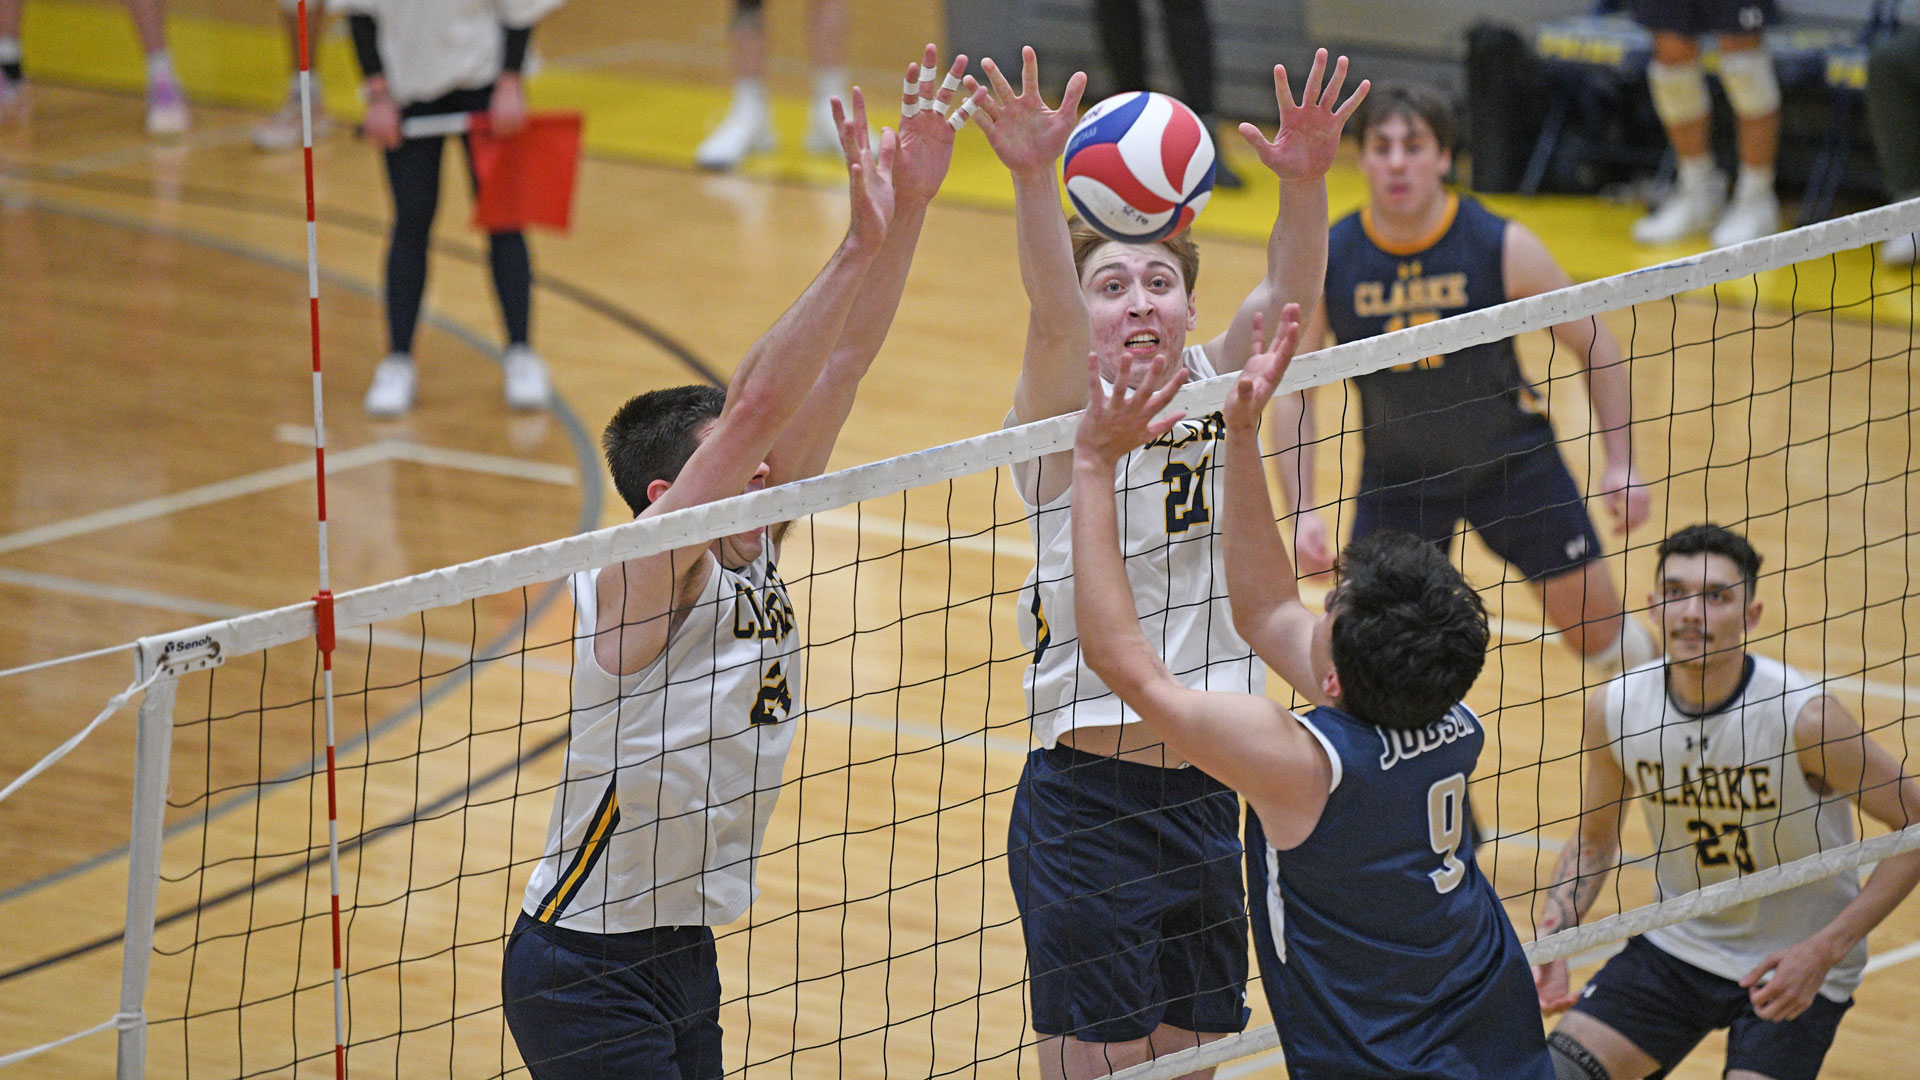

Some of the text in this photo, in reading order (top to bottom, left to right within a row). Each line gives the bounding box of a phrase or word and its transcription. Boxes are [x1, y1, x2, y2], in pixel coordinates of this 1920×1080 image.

[1161, 454, 1211, 535] 21
[176, 635, 212, 652] Senoh
[1637, 760, 1776, 810] CLARKE
[1427, 772, 1466, 894] 9
[1687, 819, 1756, 873] 23
